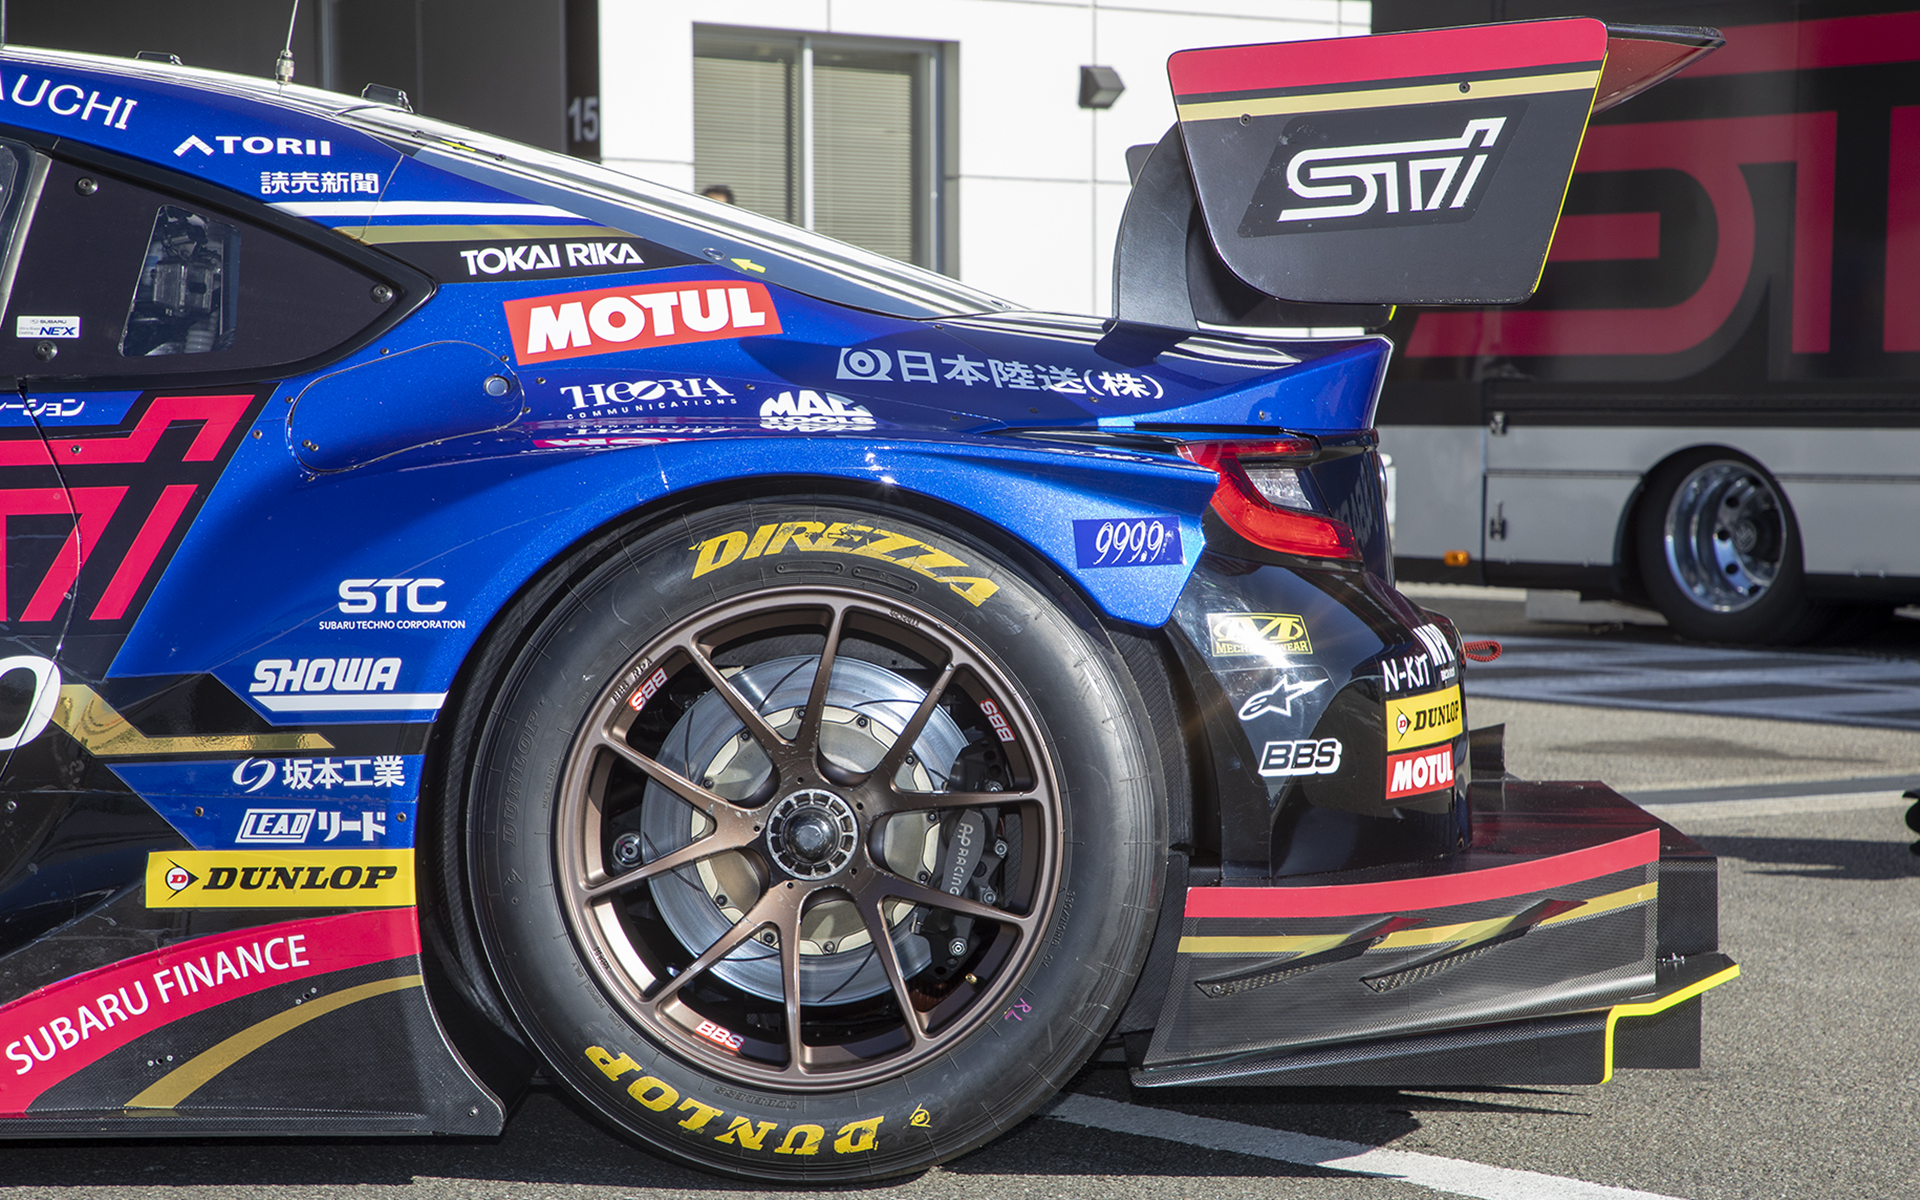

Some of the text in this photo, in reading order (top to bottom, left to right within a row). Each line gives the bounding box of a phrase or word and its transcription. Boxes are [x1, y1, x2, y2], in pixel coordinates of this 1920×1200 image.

[0, 73, 138, 130] UCHI
[568, 96, 600, 142] 15
[216, 133, 331, 156] TORII
[260, 171, 379, 194] 読売新聞
[460, 242, 644, 276] TOKAI RIKA
[527, 288, 765, 354] MOTUL
[898, 349, 1165, 399] 日本陸送(株)
[0, 398, 85, 417] ーション
[567, 398, 737, 420] COMMUNICATIONS
[760, 390, 874, 417] MAC
[689, 521, 1000, 607] DIREZZA
[338, 578, 447, 613] STC
[319, 619, 466, 630] SUBARU TECHNO CORPORATION
[249, 657, 402, 693] SHOWA
[629, 667, 668, 712] BBS
[980, 699, 1015, 742] BBS
[1413, 700, 1459, 731] DUNLOP
[282, 755, 406, 791] 坂本工業
[1258, 738, 1342, 777] BBS
[1390, 751, 1453, 793] MOTUL
[502, 710, 540, 846] DUNLOP
[242, 811, 386, 842] LEAD リード
[202, 866, 398, 891] DUNLOP
[949, 847, 969, 897] RACING
[5, 934, 310, 1075] SUBARU FINANCE
[695, 1020, 746, 1052] BBS
[584, 1045, 885, 1156] DUNLOP
